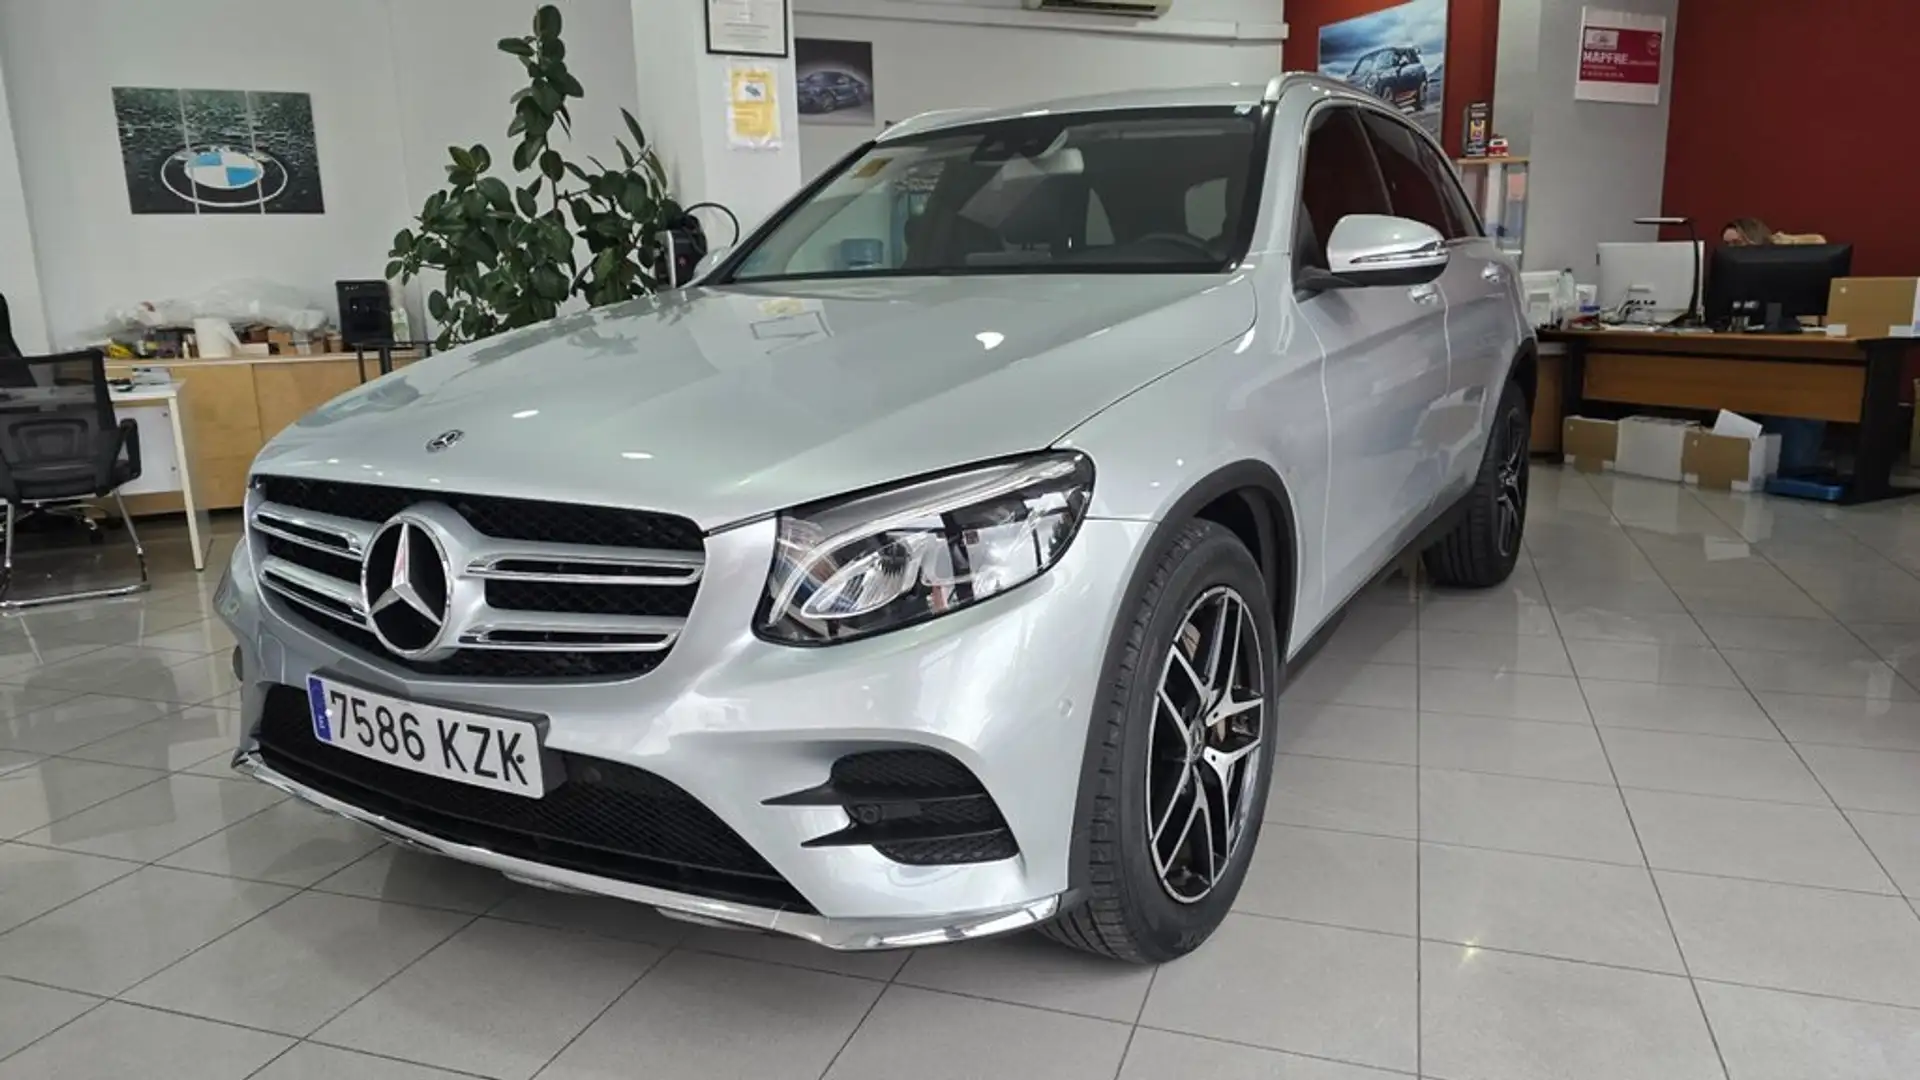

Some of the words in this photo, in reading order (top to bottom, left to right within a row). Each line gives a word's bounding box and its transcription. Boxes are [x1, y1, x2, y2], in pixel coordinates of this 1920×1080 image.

[1583, 51, 1628, 65] MAPFRE
[330, 691, 425, 762] 7586
[437, 719, 528, 785] KZK
